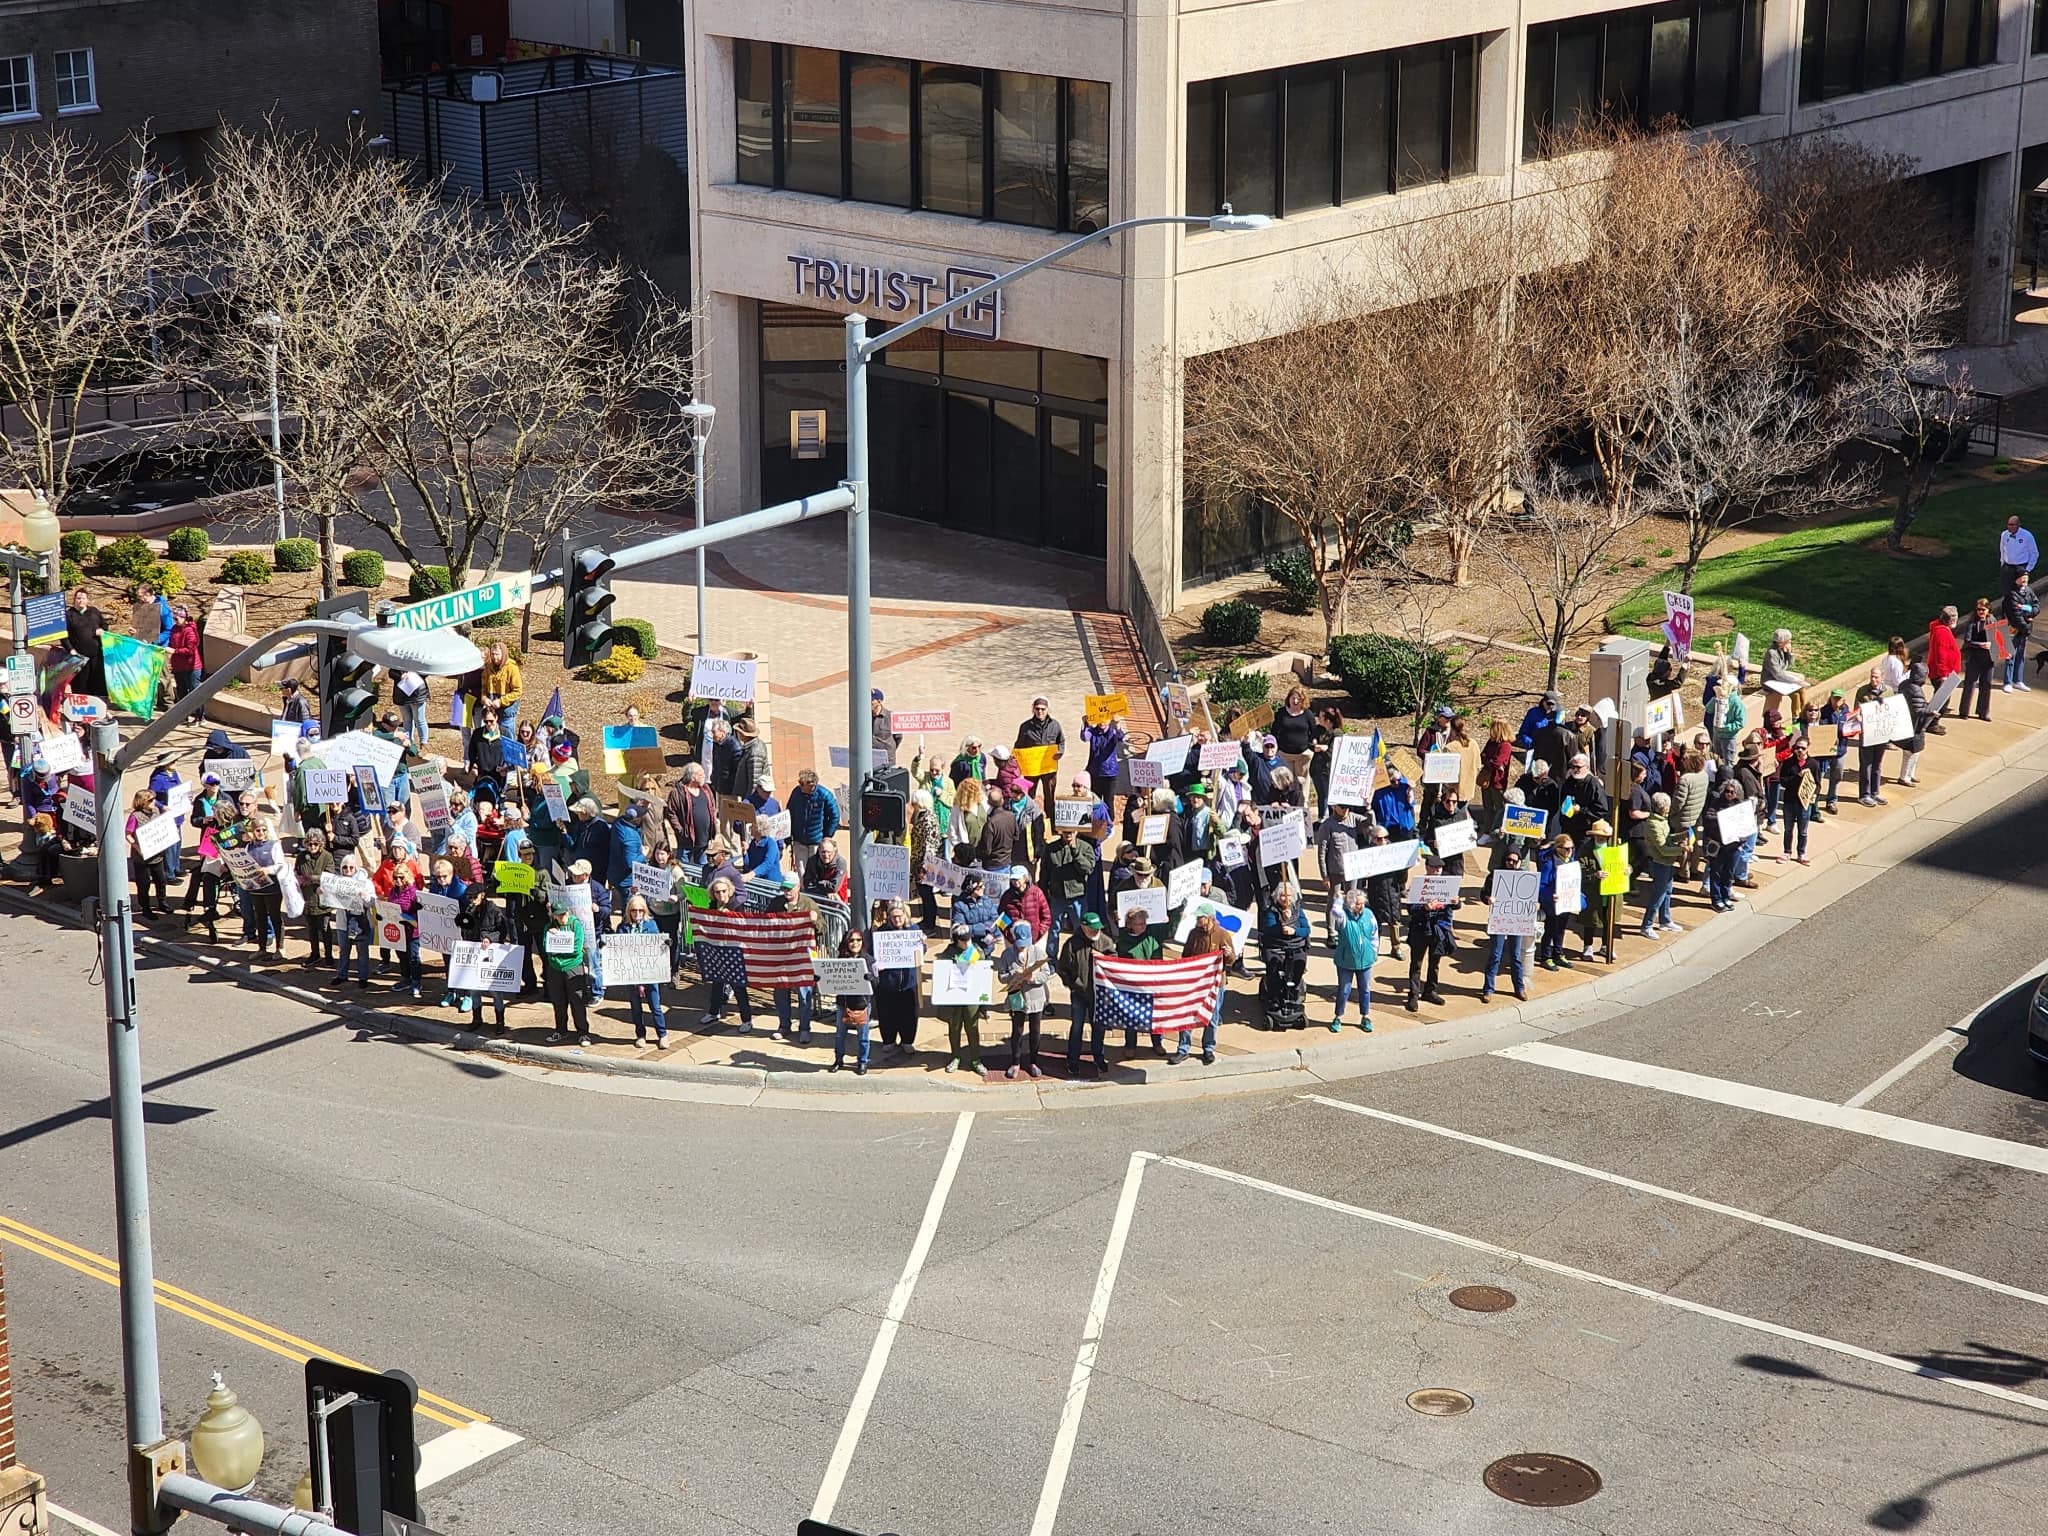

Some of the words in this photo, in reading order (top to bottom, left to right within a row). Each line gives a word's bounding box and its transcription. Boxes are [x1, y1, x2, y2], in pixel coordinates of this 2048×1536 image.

[787, 255, 937, 316] TRUIST
[1667, 593, 1691, 611] GREED
[398, 593, 475, 631] ANKLIN
[478, 587, 495, 602] RD
[697, 659, 729, 673] MUSK
[735, 662, 747, 674] IS
[695, 683, 748, 699] Unelected
[898, 715, 919, 723] MAKE
[922, 713, 945, 722] LYING
[895, 722, 923, 730] WRONG
[925, 720, 950, 730] AGAIN
[222, 767, 252, 777] DEPORT
[1340, 764, 1374, 776] BIGGEST
[225, 775, 249, 784] MUSK
[312, 772, 344, 784] CLINE
[1133, 776, 1163, 784] ACTIONS
[314, 787, 342, 797] AWOL
[82, 798, 94, 808] NO
[1055, 801, 1080, 811] WHERE'S
[1055, 810, 1078, 821] BEN?
[1509, 820, 1540, 830] UKRAINE
[870, 847, 906, 860] JUDGES
[634, 873, 666, 888] PROJECT
[869, 872, 888, 880] HOLD
[891, 872, 906, 880] THE
[639, 884, 661, 895] 2025
[1494, 873, 1538, 900] NO
[384, 928, 400, 937] STOP
[605, 935, 667, 947] REPUBLICANS
[607, 946, 623, 958] TRY
[455, 954, 479, 965] BEN?
[607, 958, 626, 970] FOR
[629, 957, 659, 969] WEAK
[482, 969, 514, 980] TRAITOR
